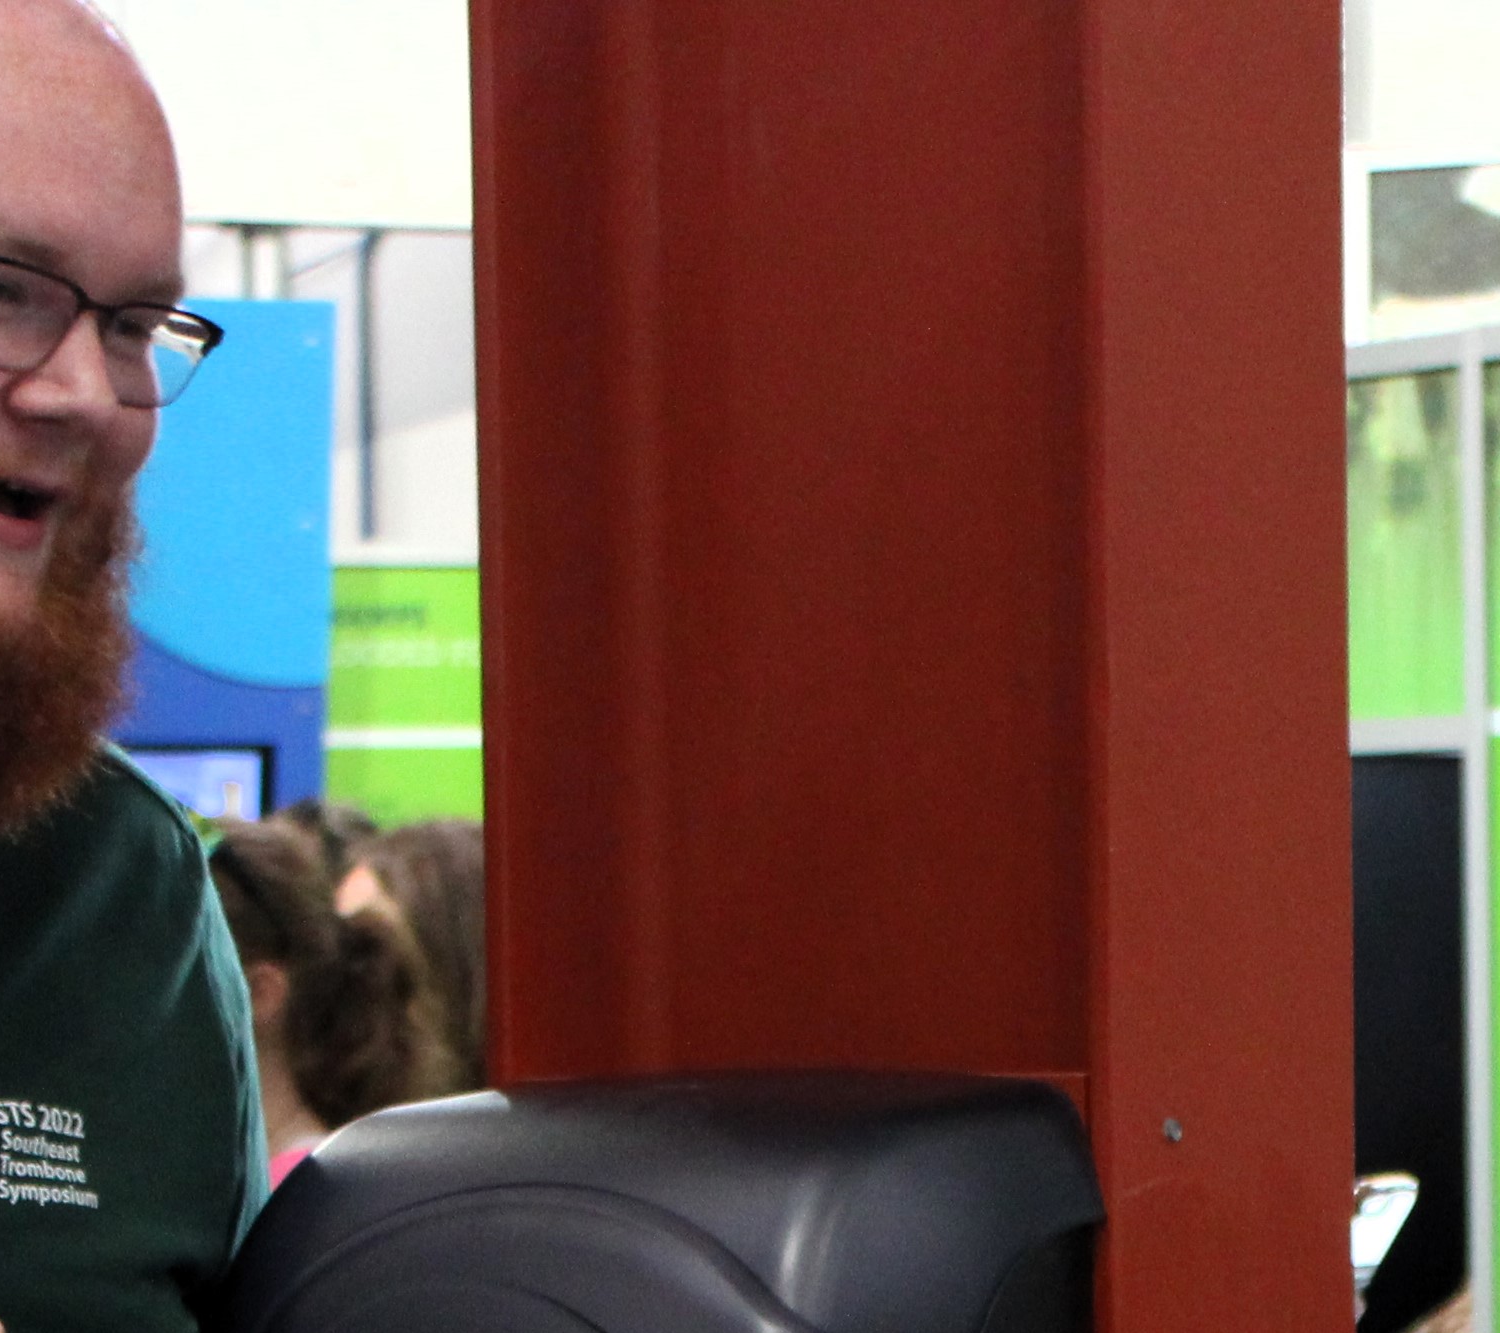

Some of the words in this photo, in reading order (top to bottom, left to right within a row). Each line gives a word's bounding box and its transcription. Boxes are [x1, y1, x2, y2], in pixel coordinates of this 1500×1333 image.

[38, 1103, 85, 1140] 2022
[1, 1129, 80, 1163] Southeast
[0, 1153, 87, 1184] Trombone
